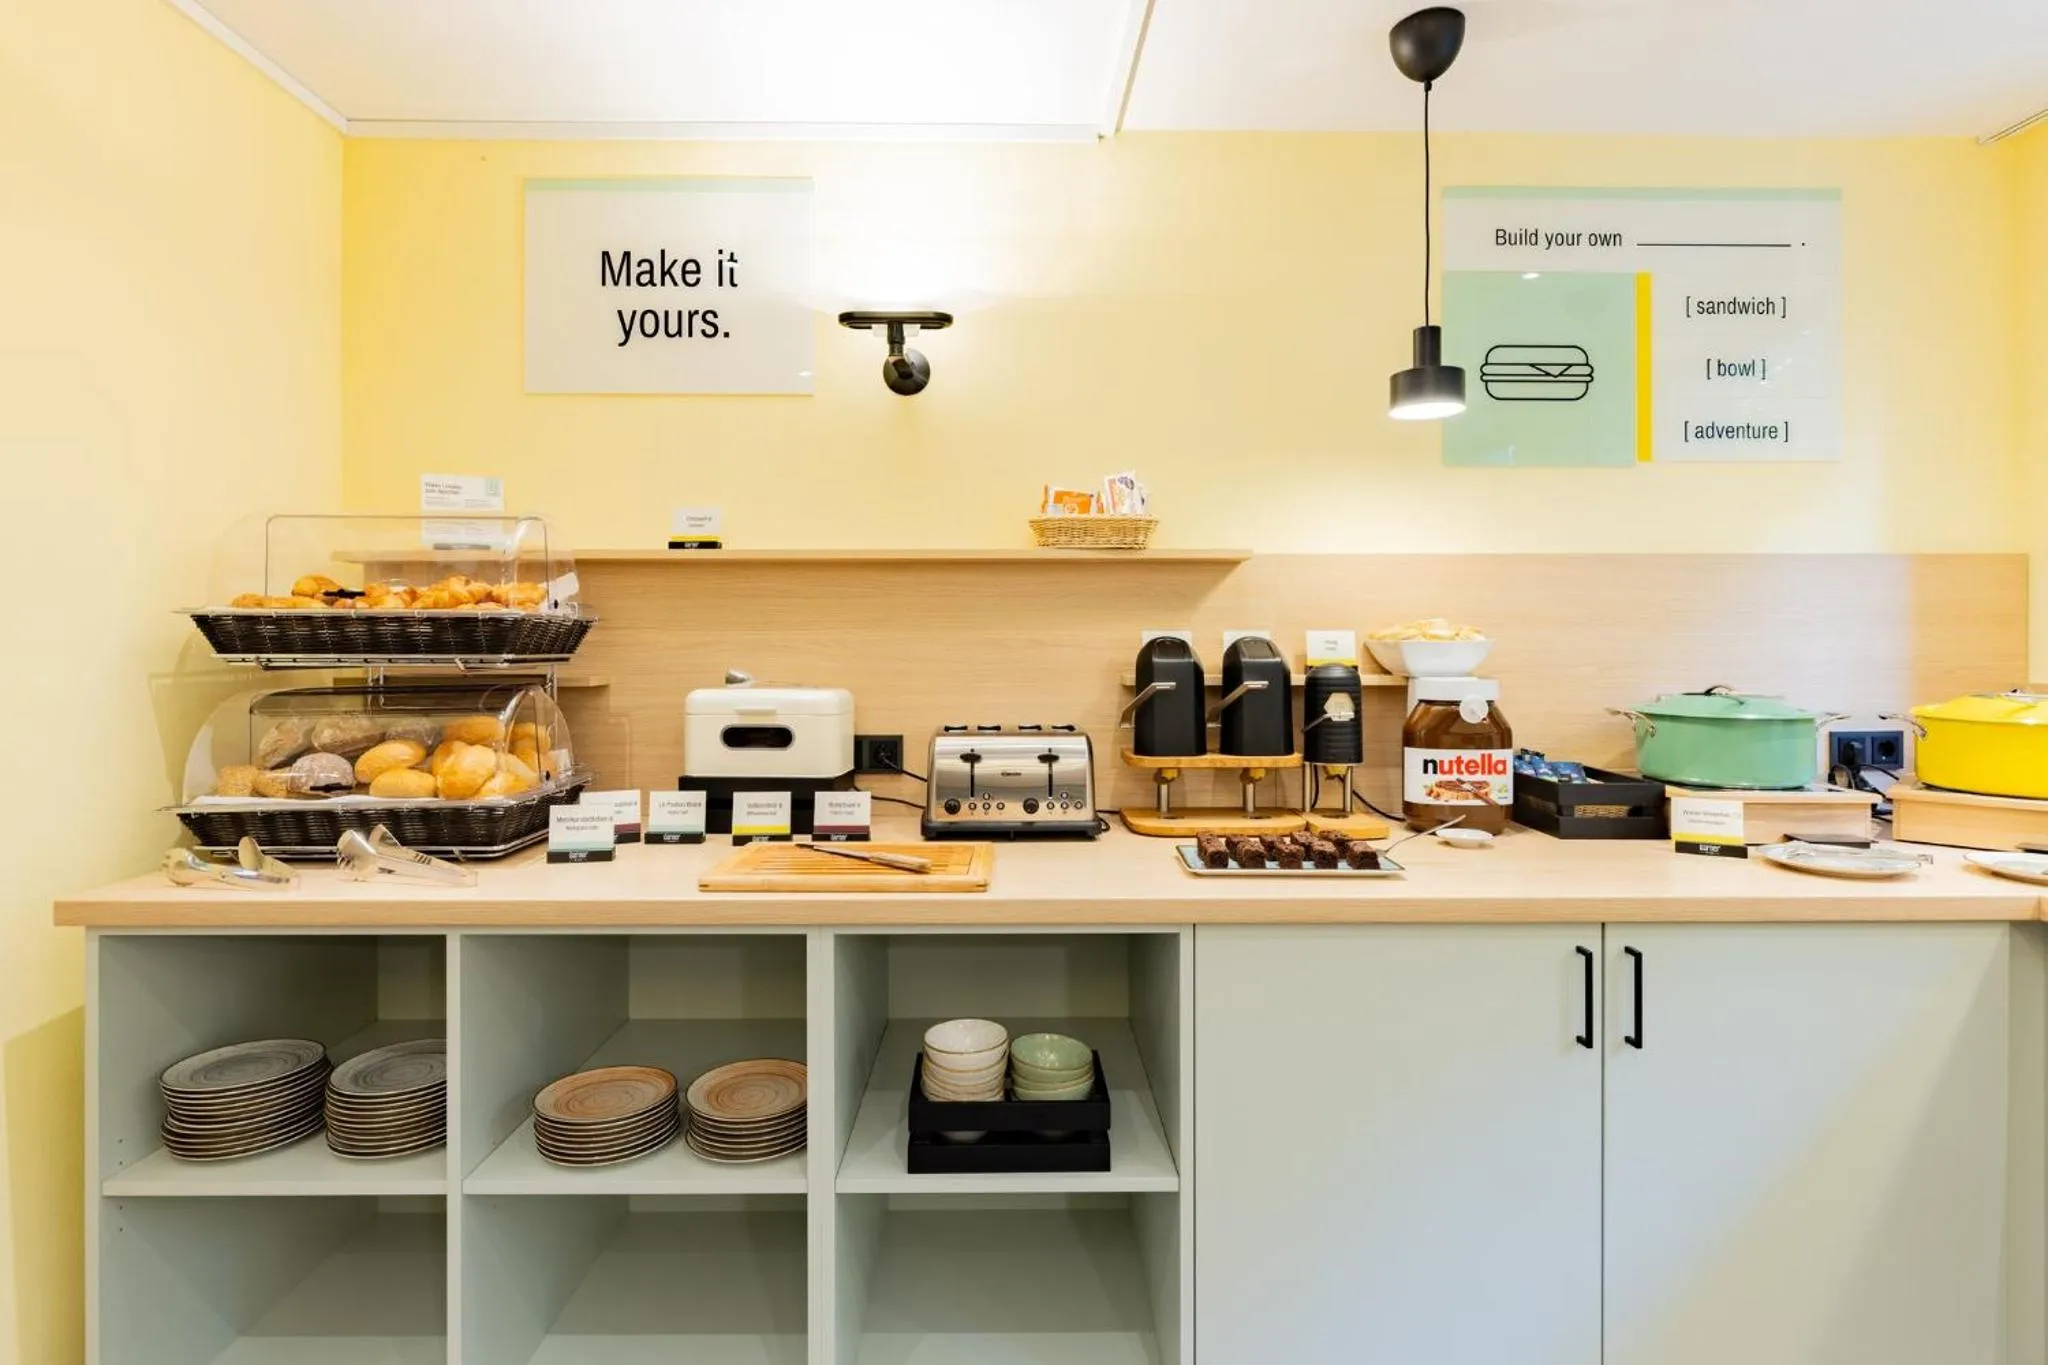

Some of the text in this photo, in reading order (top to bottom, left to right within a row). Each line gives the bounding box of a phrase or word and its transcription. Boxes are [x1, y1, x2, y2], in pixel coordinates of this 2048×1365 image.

[1495, 227, 1539, 247] Build
[1544, 231, 1583, 250] your
[1588, 231, 1623, 247] own
[601, 248, 739, 288] Make it
[1696, 296, 1776, 316] sandwich
[616, 308, 730, 348] yours.
[1716, 358, 1756, 378] bowl
[1694, 421, 1779, 440] adventure
[1422, 752, 1507, 776] nutella
